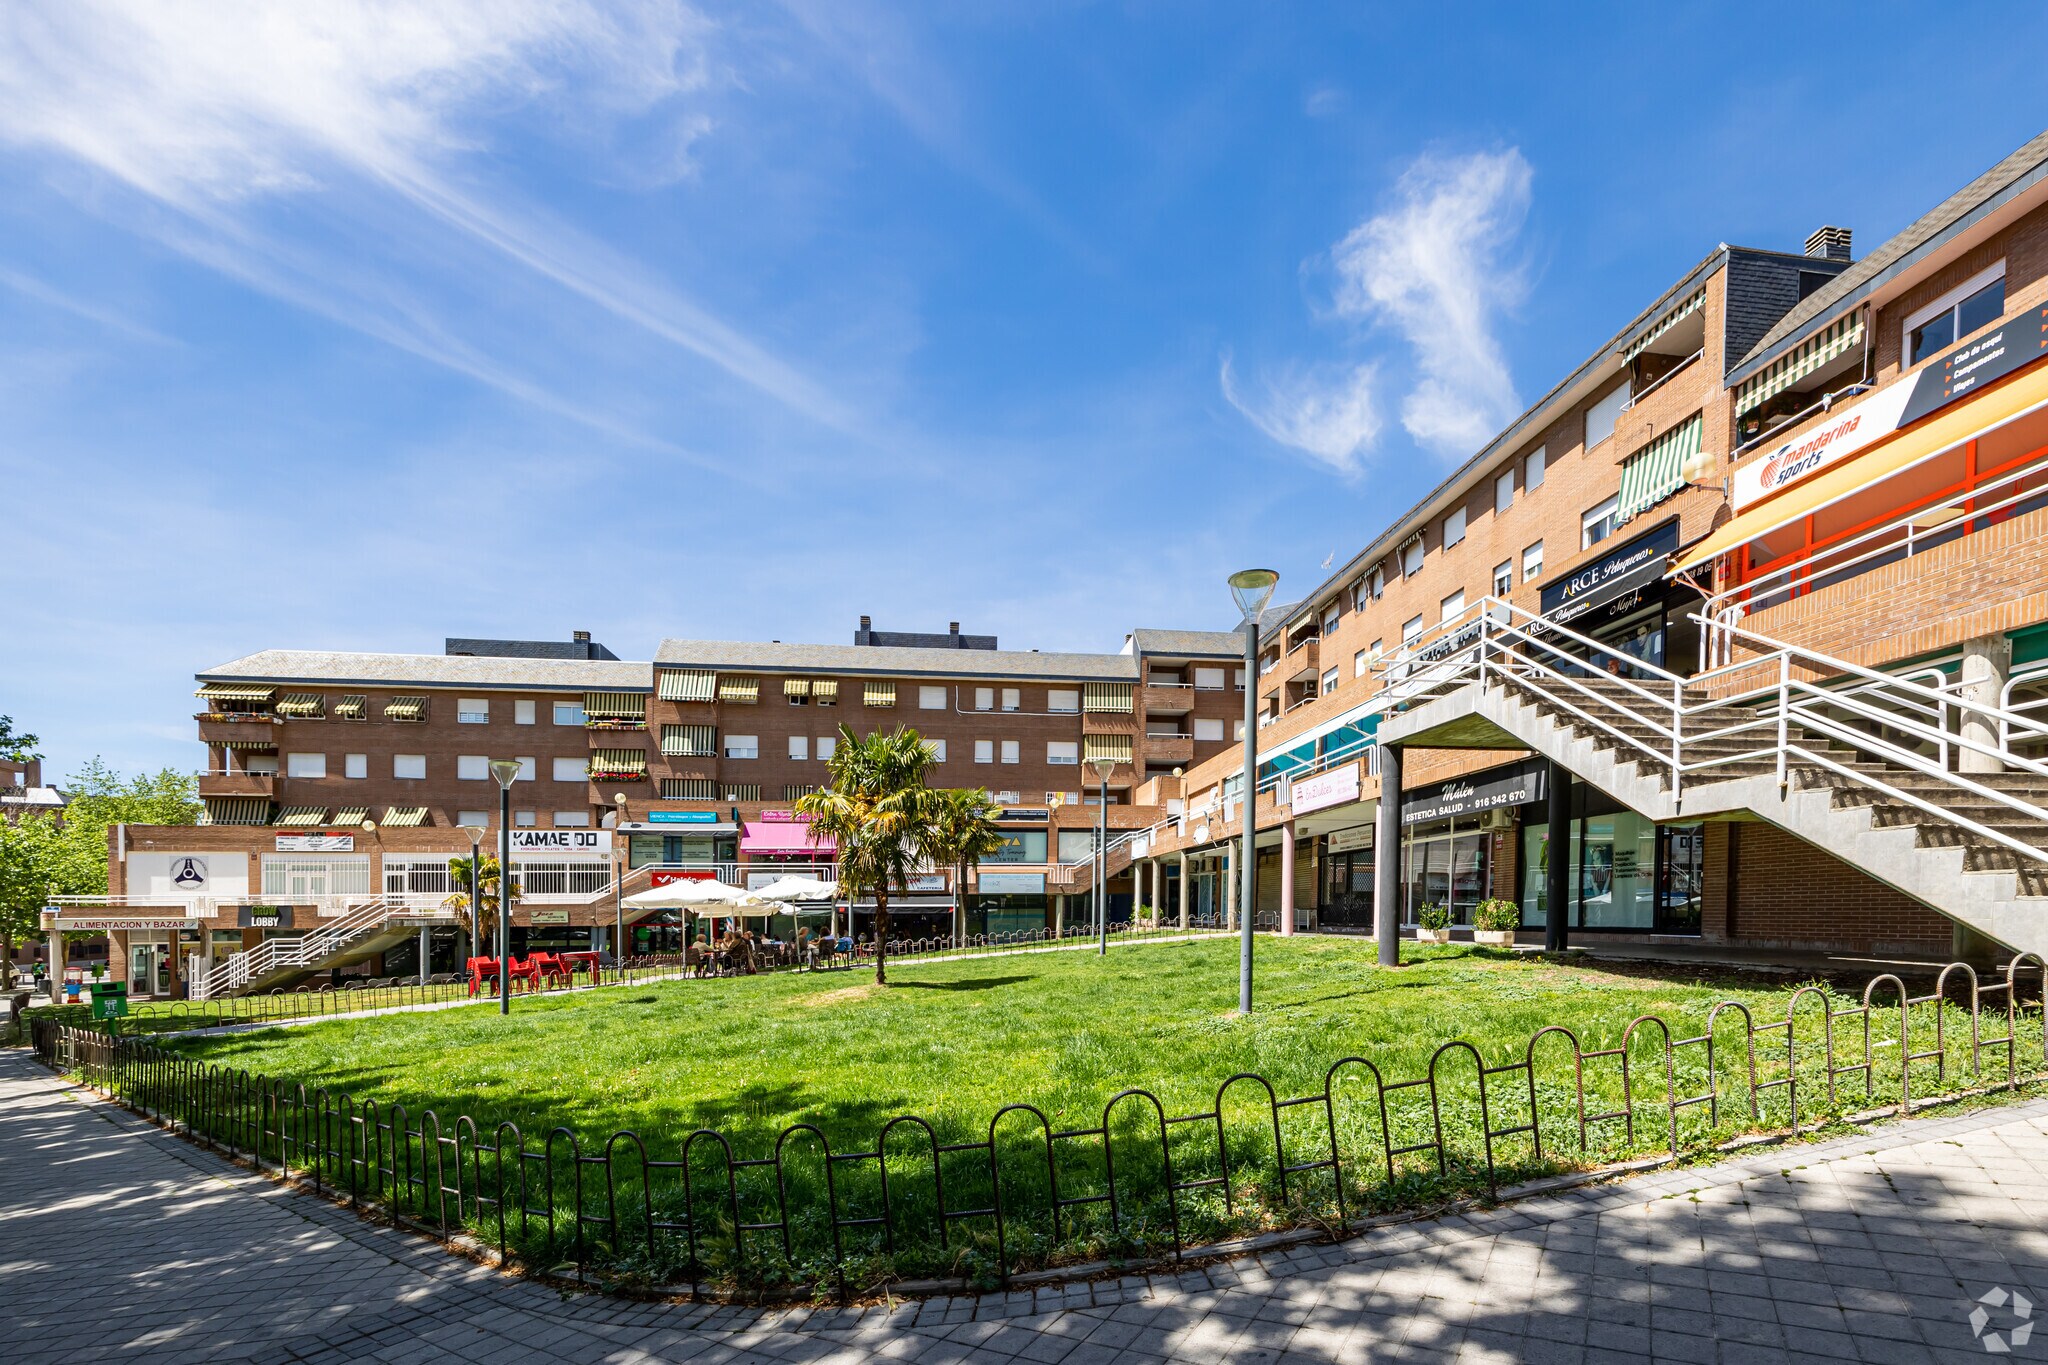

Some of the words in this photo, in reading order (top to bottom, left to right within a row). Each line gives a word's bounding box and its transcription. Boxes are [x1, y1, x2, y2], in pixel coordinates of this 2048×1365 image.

[1954, 351, 1970, 365] Club
[1971, 346, 1980, 356] de
[1954, 347, 2005, 379] Campamentos
[1953, 377, 1975, 393] Viajes
[1782, 415, 1861, 468] mandarina
[1776, 450, 1824, 484] sports
[1561, 567, 1600, 600] ARCE
[1442, 782, 1474, 801] Malen
[1406, 808, 1436, 821] ESTETICA
[1439, 803, 1463, 815] SALUD
[1475, 798, 1489, 808] 916
[1491, 794, 1507, 805] 342
[1509, 790, 1526, 801] 670
[513, 832, 569, 846] KAMAE
[574, 832, 597, 846] DO
[252, 905, 277, 916] GROW
[73, 921, 142, 929] ALIMENTACION
[251, 916, 279, 927] LOBBY
